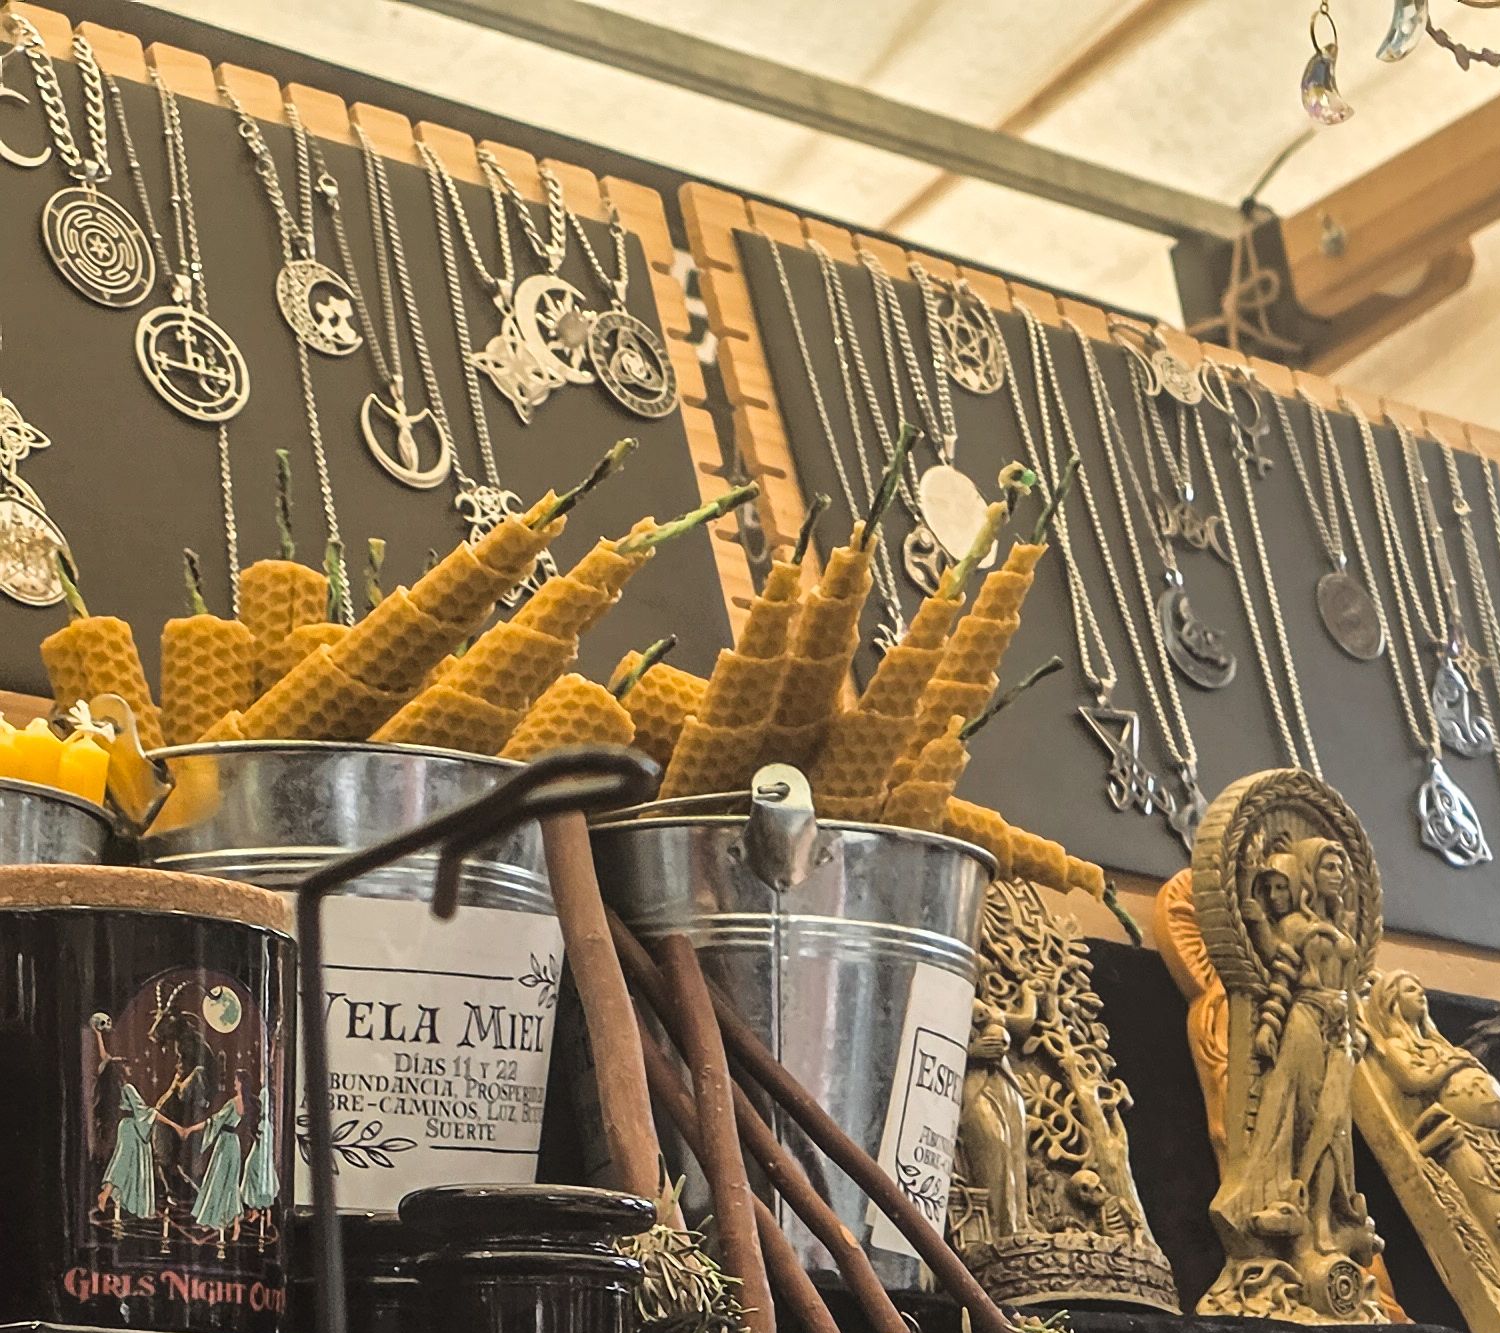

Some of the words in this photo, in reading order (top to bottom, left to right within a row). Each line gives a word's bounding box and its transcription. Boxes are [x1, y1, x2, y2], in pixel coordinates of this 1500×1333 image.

[453, 1055, 472, 1080] 11
[496, 1059, 518, 1081] 22
[329, 1072, 459, 1099] BUNDANCIA,
[425, 1116, 496, 1142] SUERTE
[64, 1267, 156, 1304] GIRLS
[160, 1270, 247, 1307] NIGHT
